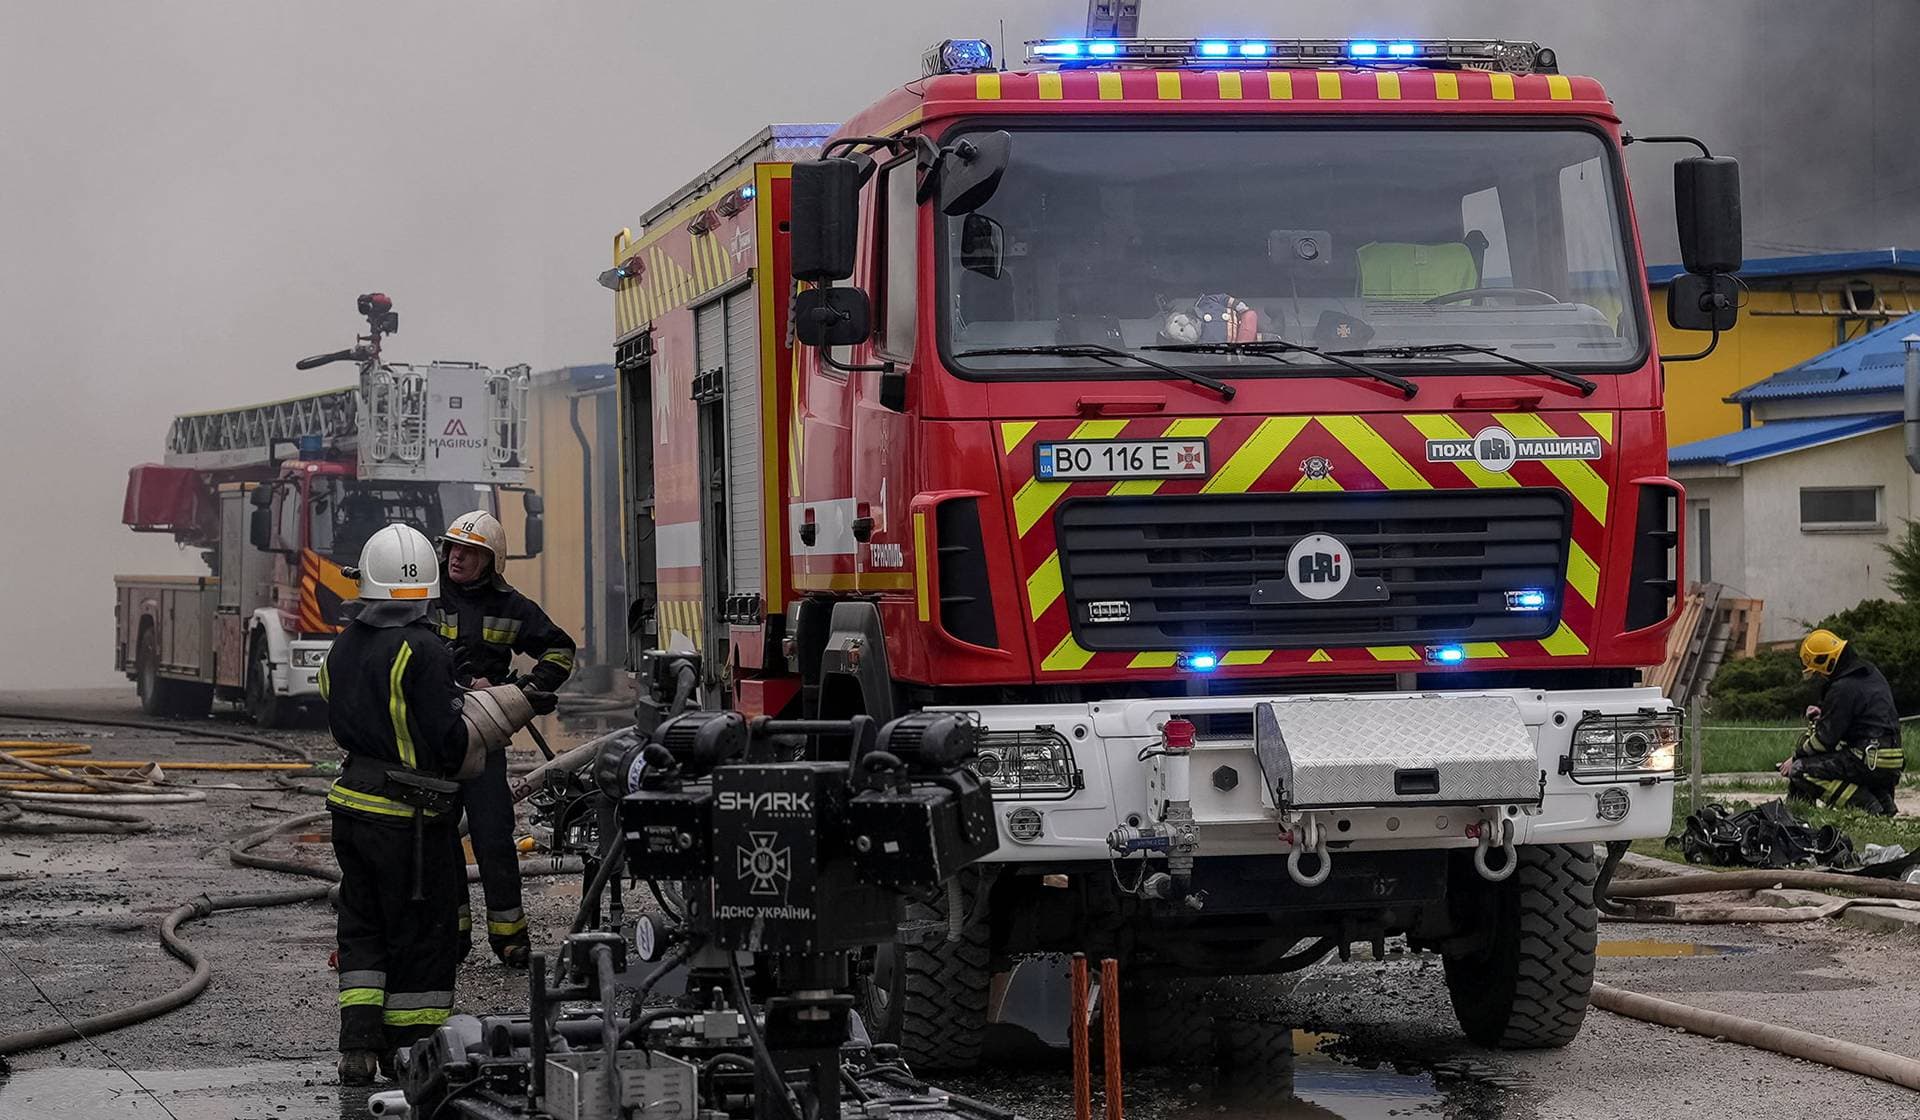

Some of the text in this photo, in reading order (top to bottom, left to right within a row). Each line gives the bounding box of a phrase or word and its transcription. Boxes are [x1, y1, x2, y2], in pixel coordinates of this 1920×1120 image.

[428, 438, 482, 448] MAGIRUS
[1432, 444, 1473, 457] ПОЖ
[1055, 446, 1170, 472] BO 116 E
[1040, 465, 1053, 473] UA
[461, 521, 475, 532] 18
[401, 563, 418, 578] 18
[718, 791, 811, 819] SHARK
[720, 905, 811, 920] ДСНС УКРАЇНИ
